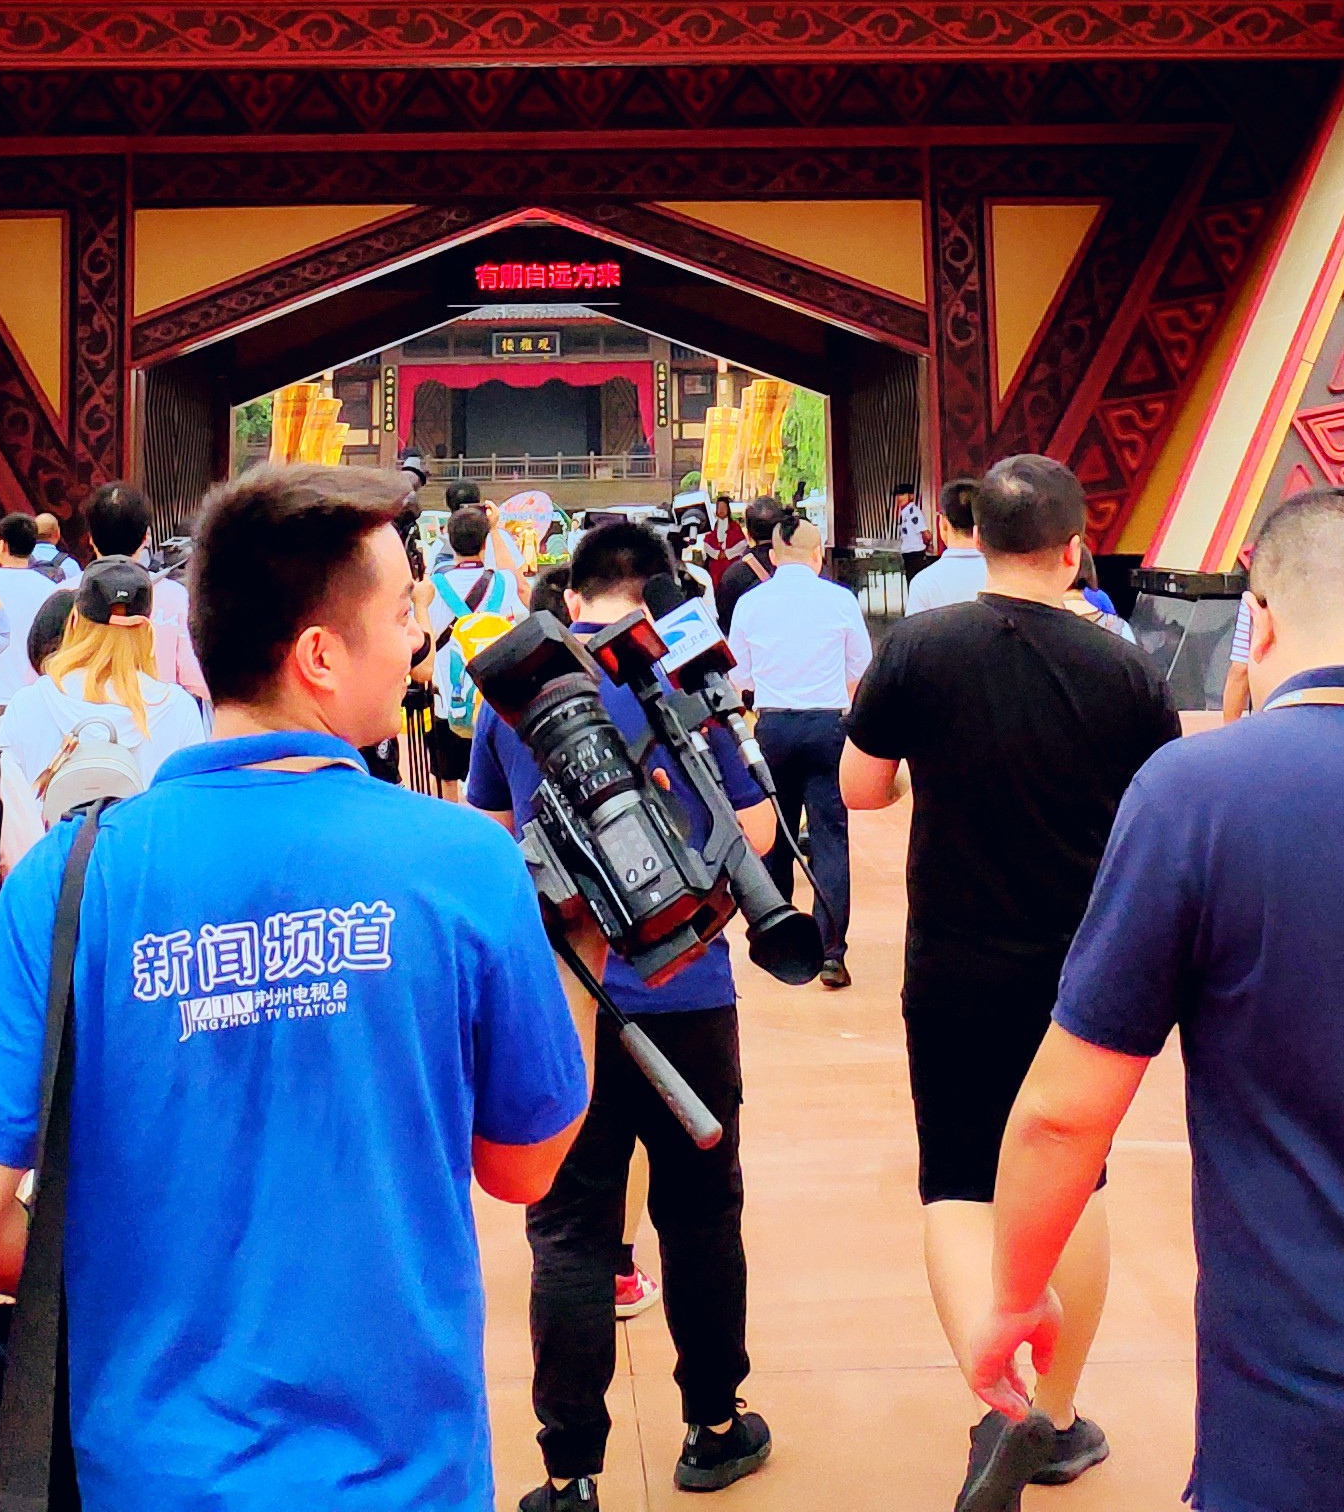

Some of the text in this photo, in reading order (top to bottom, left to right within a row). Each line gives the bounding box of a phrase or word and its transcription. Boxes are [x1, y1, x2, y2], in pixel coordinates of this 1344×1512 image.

[475, 262, 621, 289] 有朋自远方来
[132, 899, 396, 1002] 新闻频道
[178, 979, 348, 1043] JZTV 荆州电视台
[265, 1007, 282, 1021] TV
[287, 1001, 347, 1020] STATION
